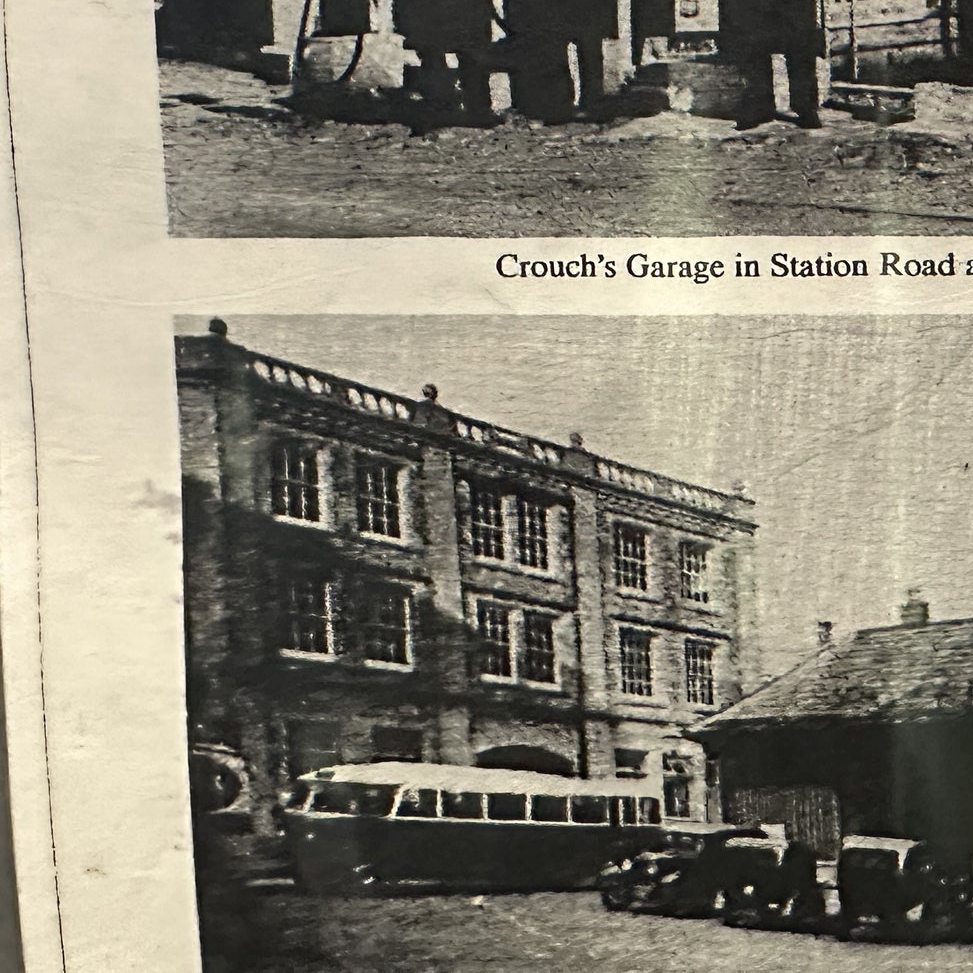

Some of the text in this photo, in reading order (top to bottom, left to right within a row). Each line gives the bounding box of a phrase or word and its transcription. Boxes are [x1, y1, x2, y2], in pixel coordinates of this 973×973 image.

[495, 253, 617, 278] Crouch's
[626, 253, 725, 284] Garage
[735, 253, 761, 278] in
[770, 252, 869, 278] Station
[880, 252, 955, 278] Road
